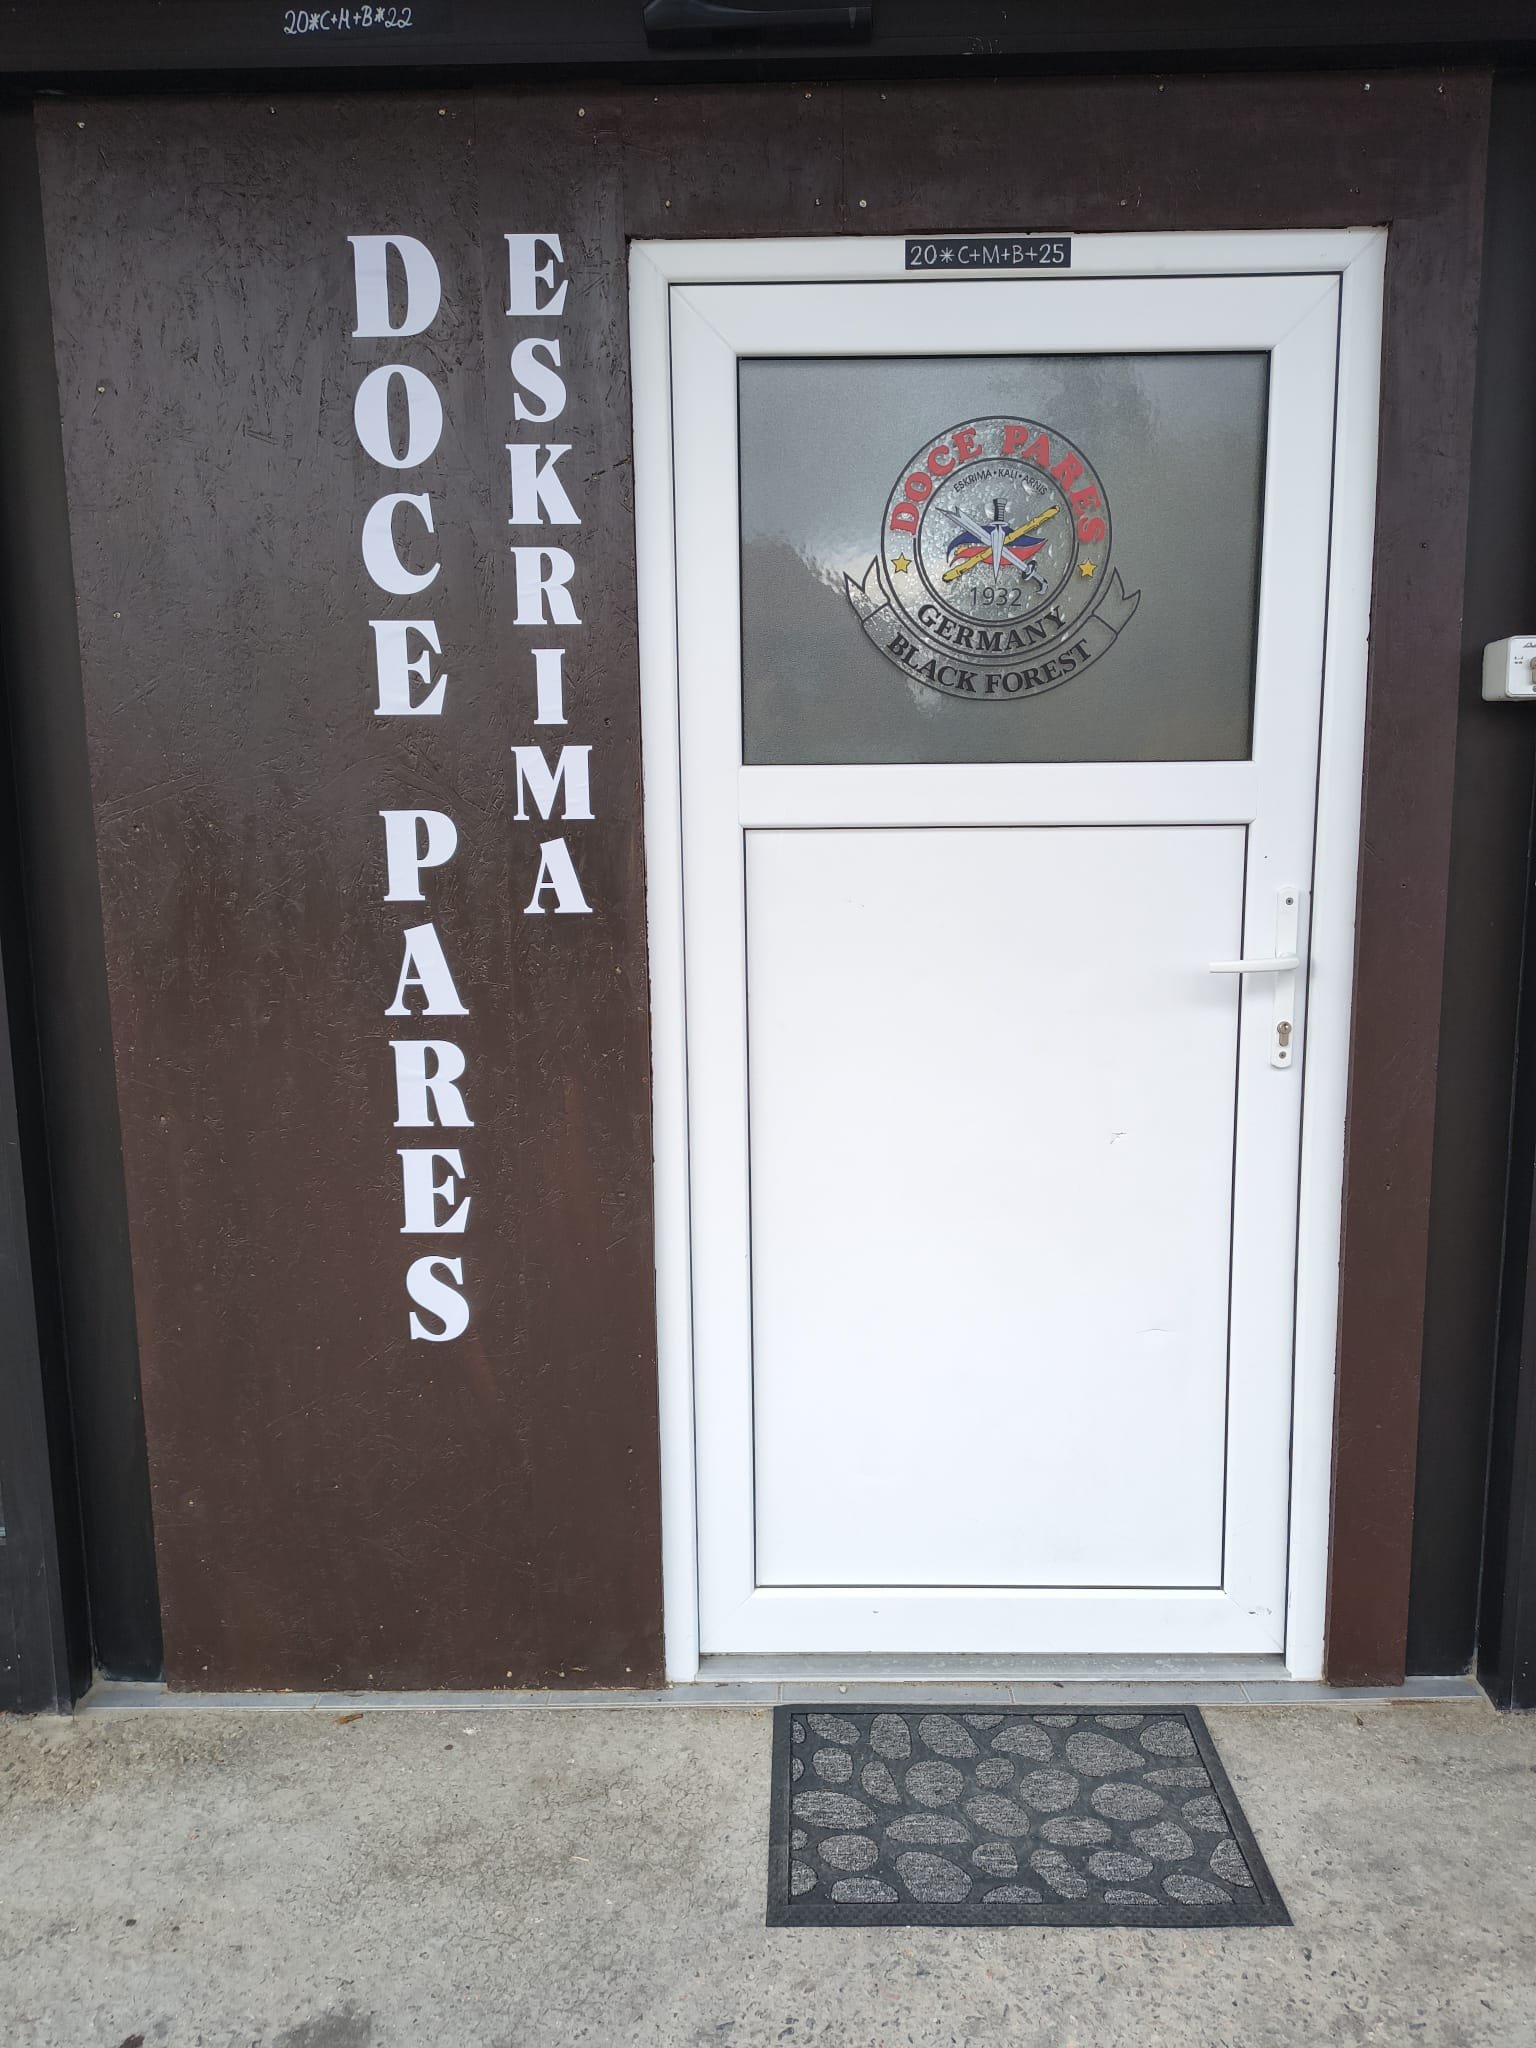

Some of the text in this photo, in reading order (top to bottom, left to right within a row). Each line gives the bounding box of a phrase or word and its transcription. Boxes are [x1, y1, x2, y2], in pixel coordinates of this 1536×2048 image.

[890, 424, 1105, 544] DOCE PARES
[504, 233, 596, 914] ESKRIMA
[970, 587, 1022, 607] 1932
[886, 632, 1092, 694] BLACK FOREST
[917, 603, 1067, 651] GERMANY
[348, 234, 475, 1342] DOCE PARES
